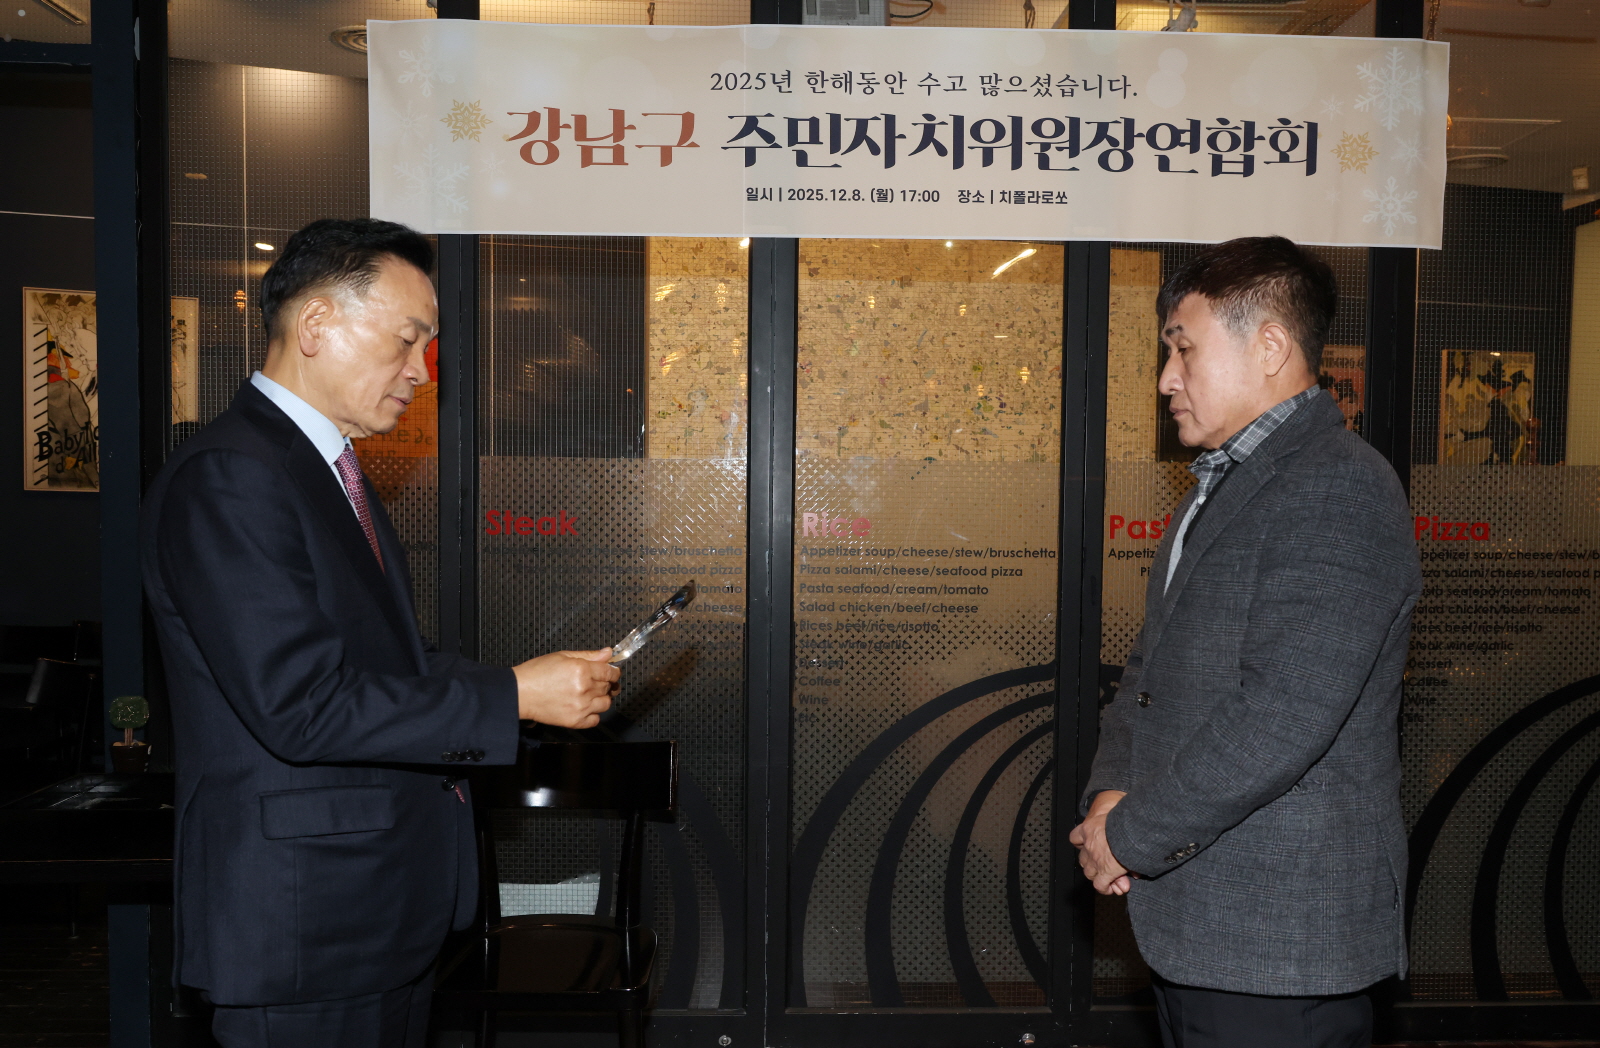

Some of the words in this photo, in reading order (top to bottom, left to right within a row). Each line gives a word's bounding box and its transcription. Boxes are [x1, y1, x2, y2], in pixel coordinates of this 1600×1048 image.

[710, 69, 793, 94] 2025년
[804, 69, 908, 96] 한해동안
[917, 71, 968, 97] 수고
[978, 72, 1138, 100] 많으셨습니다.
[506, 106, 701, 169] 강남구
[720, 112, 1319, 178] 주민자치위원장연합회
[745, 187, 773, 202] 일시
[787, 188, 865, 202] 2025.12.8.
[870, 187, 894, 204] (월)
[900, 189, 940, 203] 17:00
[957, 189, 985, 204] 장소
[999, 189, 1068, 205] 치폴라로쏘
[485, 509, 579, 536] Steak
[802, 511, 872, 538] Rice
[1414, 516, 1490, 541] Pizza
[799, 545, 862, 561] Appetizer
[865, 545, 1057, 563] soup/cheese/stew/bruschetta
[1107, 548, 1156, 560] Appetiz
[1421, 549, 1470, 562] ppetizer
[1473, 549, 1600, 562] soup/cheese/stew/b
[709, 563, 743, 580] pizza
[799, 563, 832, 576] Pizza
[834, 564, 988, 581] salami/cheese/seafood
[990, 566, 1024, 582] pizza
[799, 582, 835, 596] Pasta
[837, 583, 989, 599] seafood/cream/tomato
[799, 601, 836, 613] Salad
[838, 602, 980, 616] chicken/beef/cheese
[799, 620, 833, 632] Rices
[835, 620, 940, 634] beef/rice/risotto
[799, 675, 842, 688] Coffee
[798, 694, 829, 706] Wine
[1406, 695, 1437, 706] Wine
